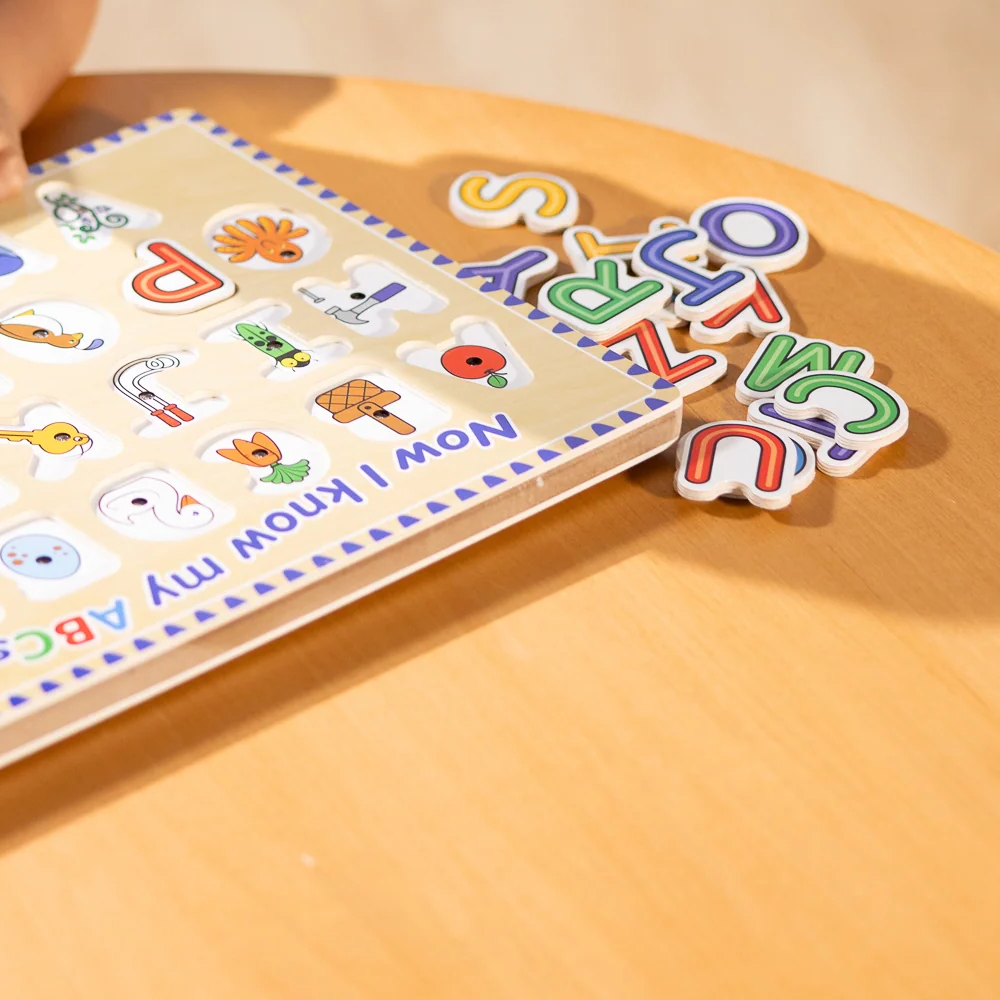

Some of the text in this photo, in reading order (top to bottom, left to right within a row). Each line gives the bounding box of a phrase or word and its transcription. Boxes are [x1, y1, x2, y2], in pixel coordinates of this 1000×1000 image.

[458, 174, 568, 218] S
[699, 202, 799, 257] O
[132, 242, 224, 303] P
[547, 260, 664, 325] R
[783, 373, 900, 434] C
[396, 413, 519, 471] Now
[684, 423, 786, 493] U
[359, 463, 389, 489] I
[231, 477, 363, 559] know
[147, 556, 226, 606] my
